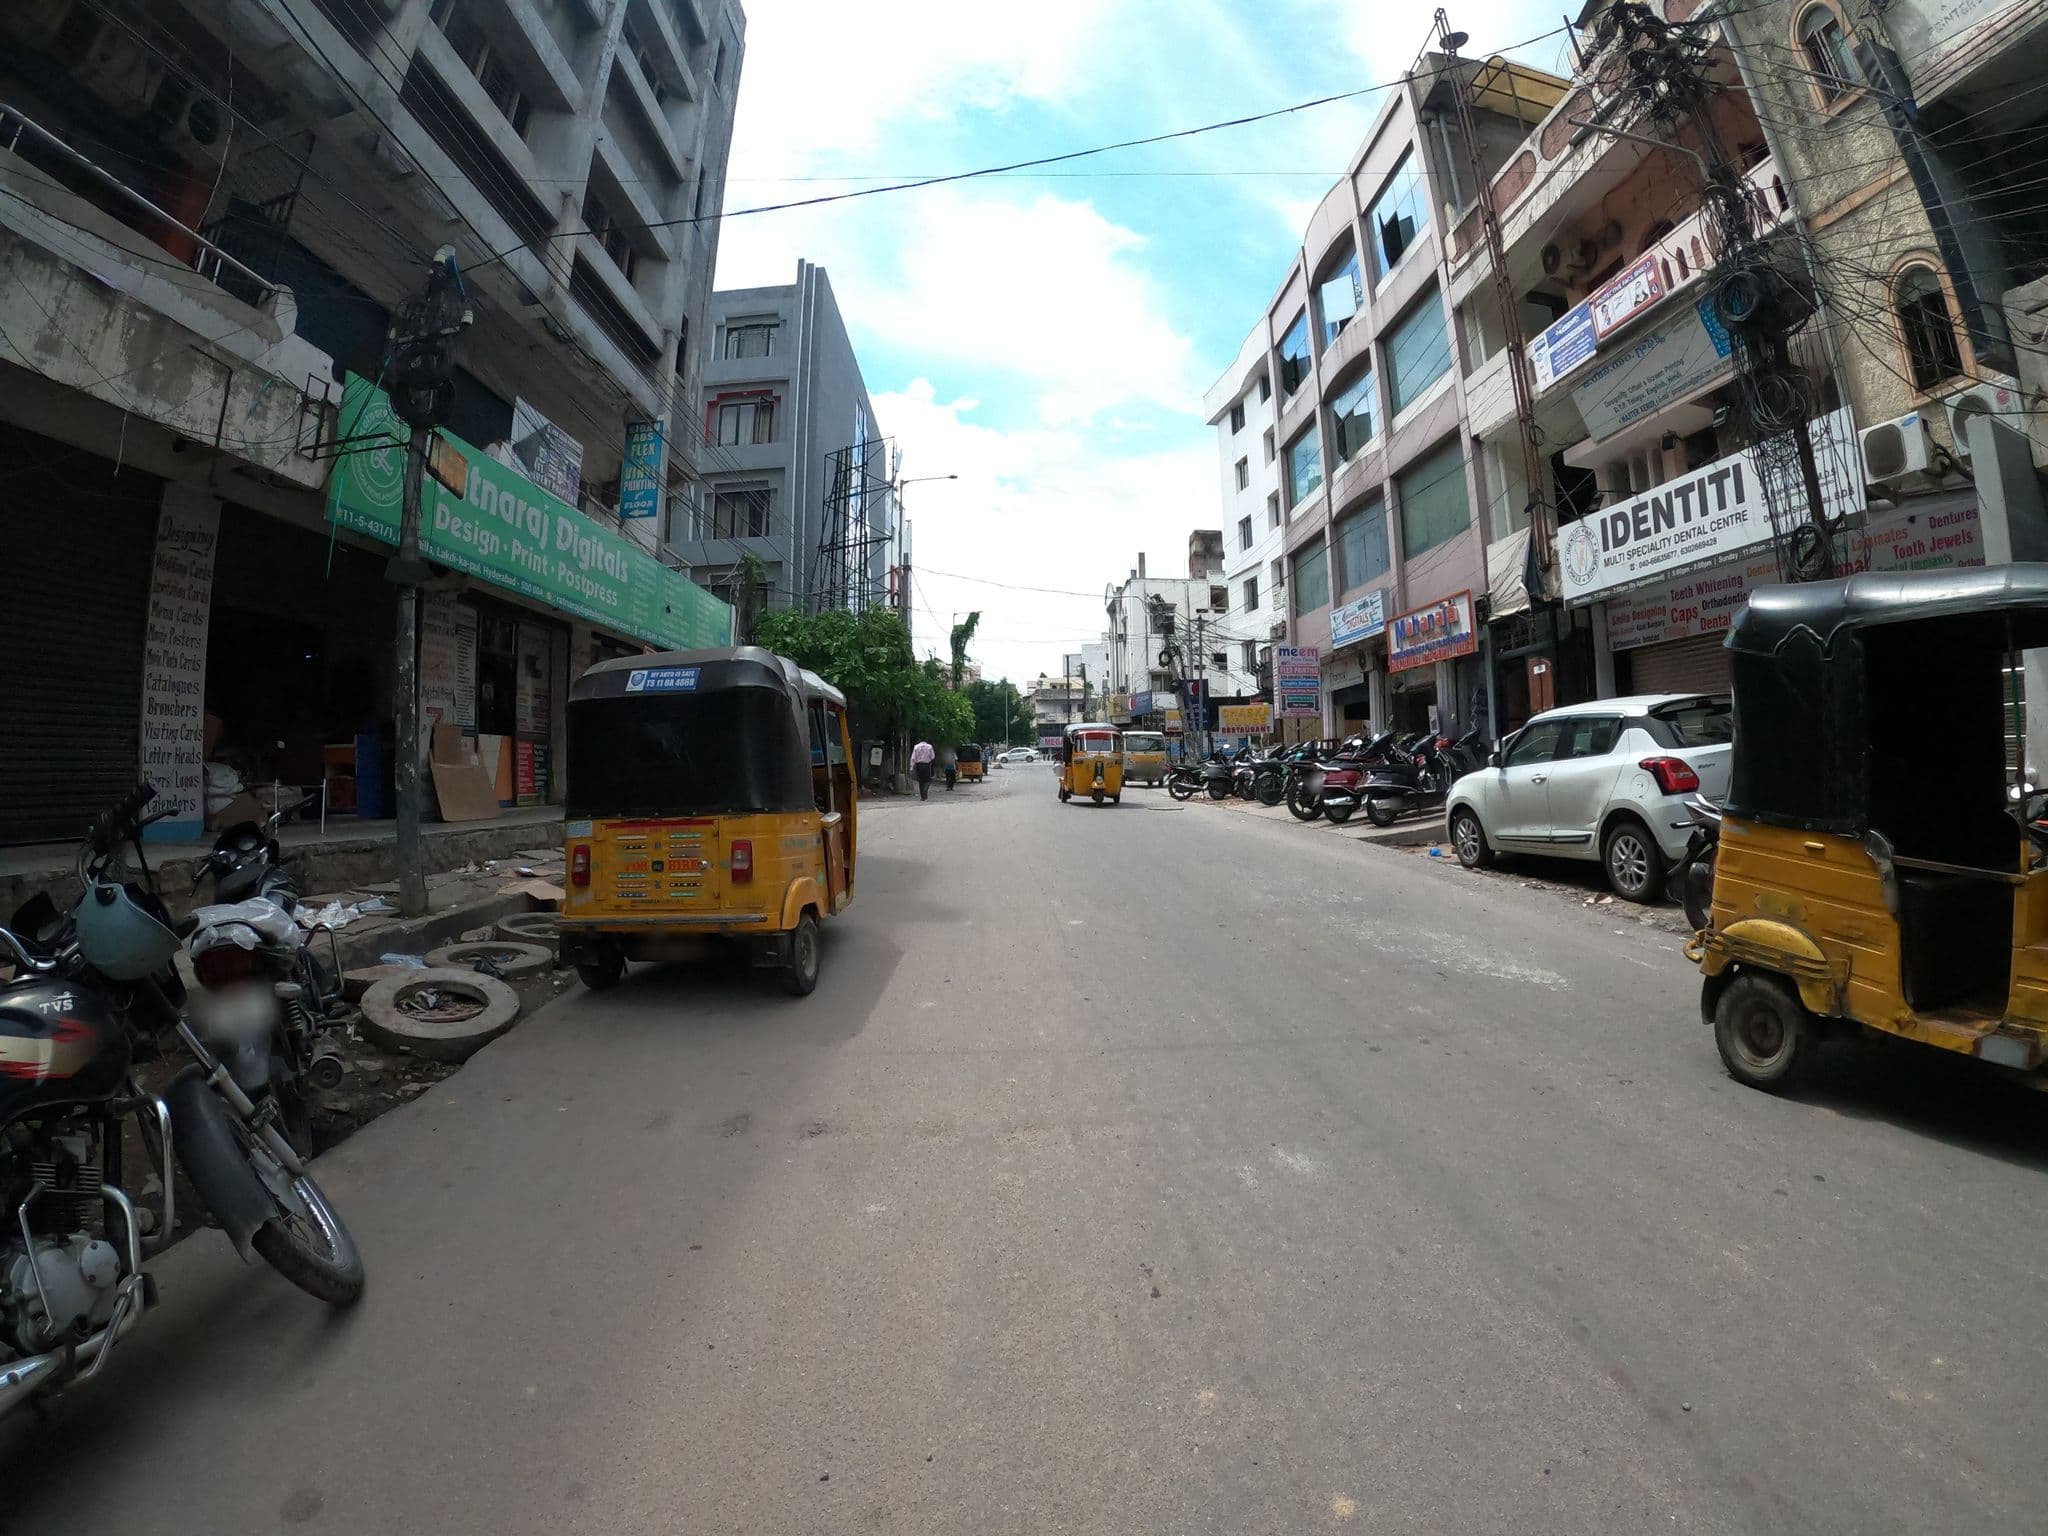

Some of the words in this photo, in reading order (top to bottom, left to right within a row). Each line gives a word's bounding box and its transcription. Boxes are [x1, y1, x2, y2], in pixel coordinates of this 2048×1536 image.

[630, 442, 656, 458] FLEX
[1600, 463, 1745, 552] IDENTITI
[1929, 507, 1978, 529] Dentures
[555, 515, 628, 584] Digitals
[1603, 552, 1626, 569] MULTI
[1626, 526, 1672, 563] SPECIALITY
[1674, 525, 1707, 546] DENTAL
[1709, 509, 1749, 533] CENTRE
[1893, 539, 1926, 560] Tooth
[1930, 529, 1974, 552] Jewels
[435, 503, 500, 556] Design
[511, 538, 548, 577] Print
[557, 560, 618, 607] Postpress
[1671, 585, 1694, 601] Teeth
[1696, 575, 1743, 595] Whitening
[176, 603, 203, 627] Cards
[1671, 605, 1698, 625] Caps
[1701, 612, 1731, 632] Dental
[169, 626, 202, 649] Posters
[1279, 647, 1318, 662] meem
[146, 672, 201, 697] Catalogues
[144, 721, 179, 745] Visiting
[180, 722, 204, 742] Cards
[1221, 726, 1271, 734] RESTAURANT
[174, 746, 202, 764] Heads
[174, 770, 201, 793] Logos
[39, 999, 73, 1014] TVS
